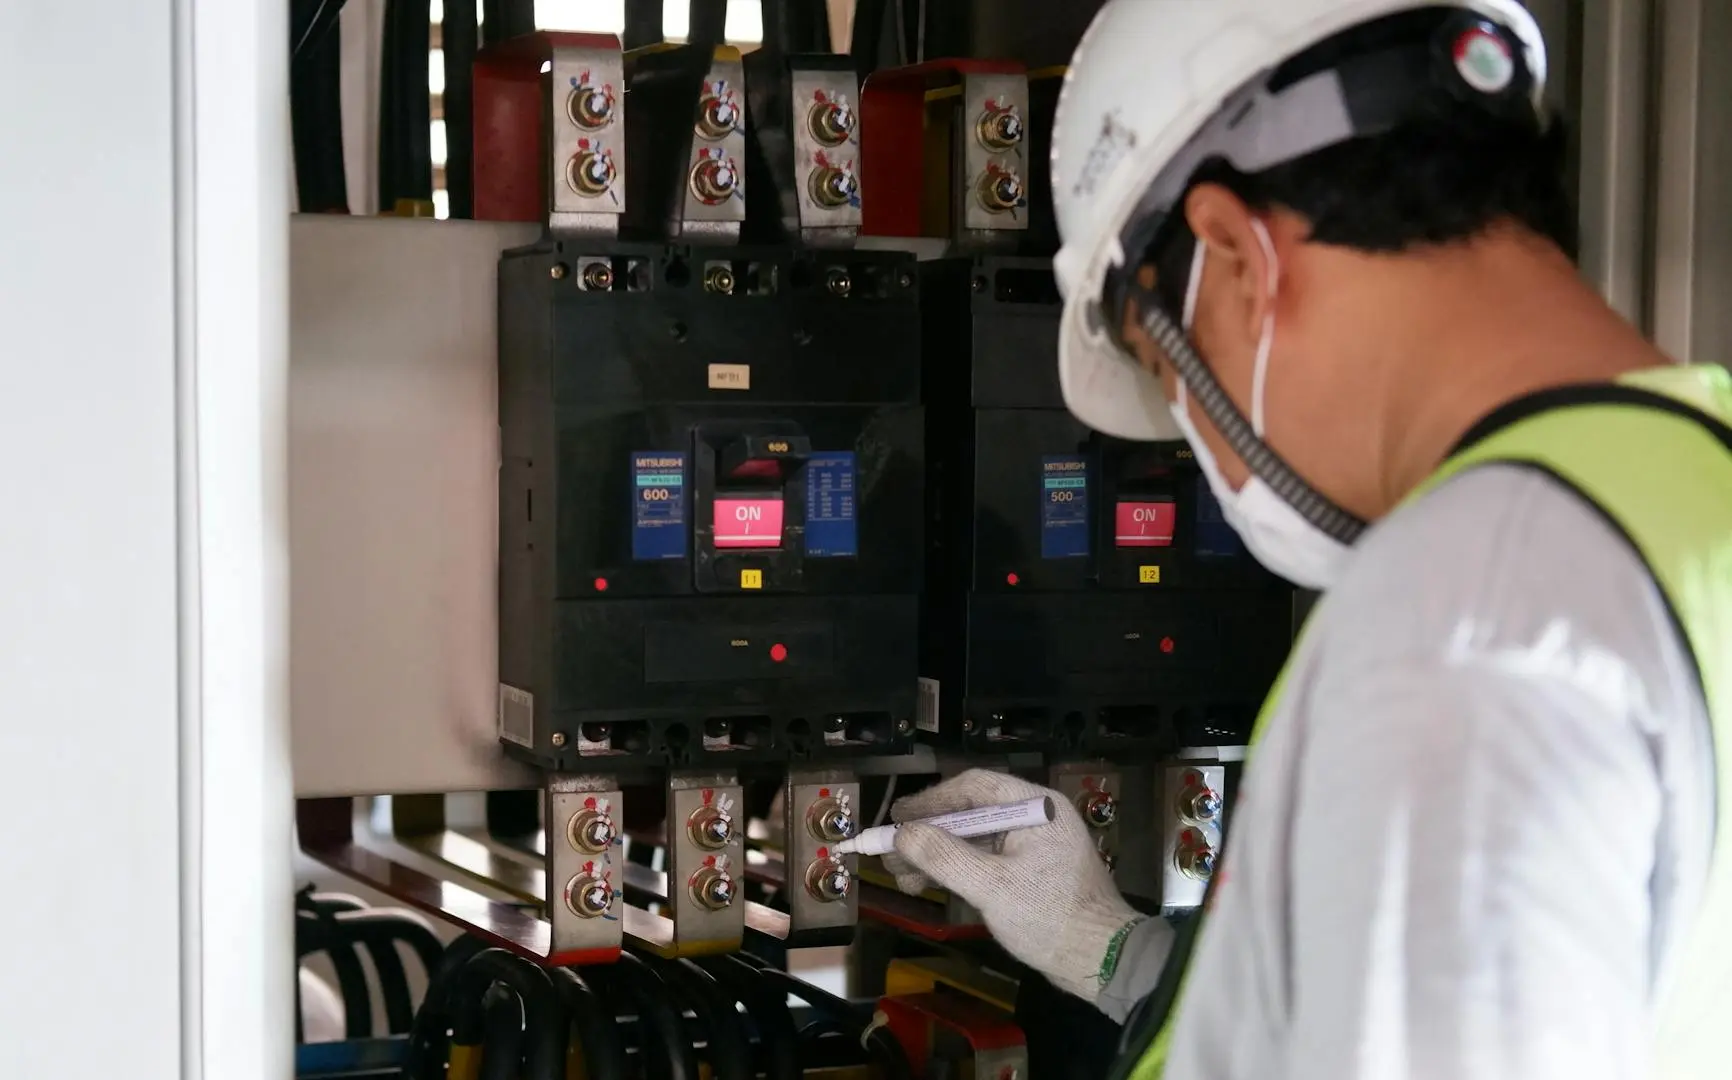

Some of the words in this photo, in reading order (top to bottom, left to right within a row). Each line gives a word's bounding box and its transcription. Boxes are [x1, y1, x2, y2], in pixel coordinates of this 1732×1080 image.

[636, 458, 682, 467] MITSUBISHI
[1044, 462, 1085, 471] MITSUBISHI
[643, 489, 669, 501] 600
[1051, 491, 1073, 503] 500
[735, 506, 761, 521] ON
[1133, 508, 1156, 522] ON
[745, 574, 757, 584] 11
[1144, 570, 1156, 580] 12
